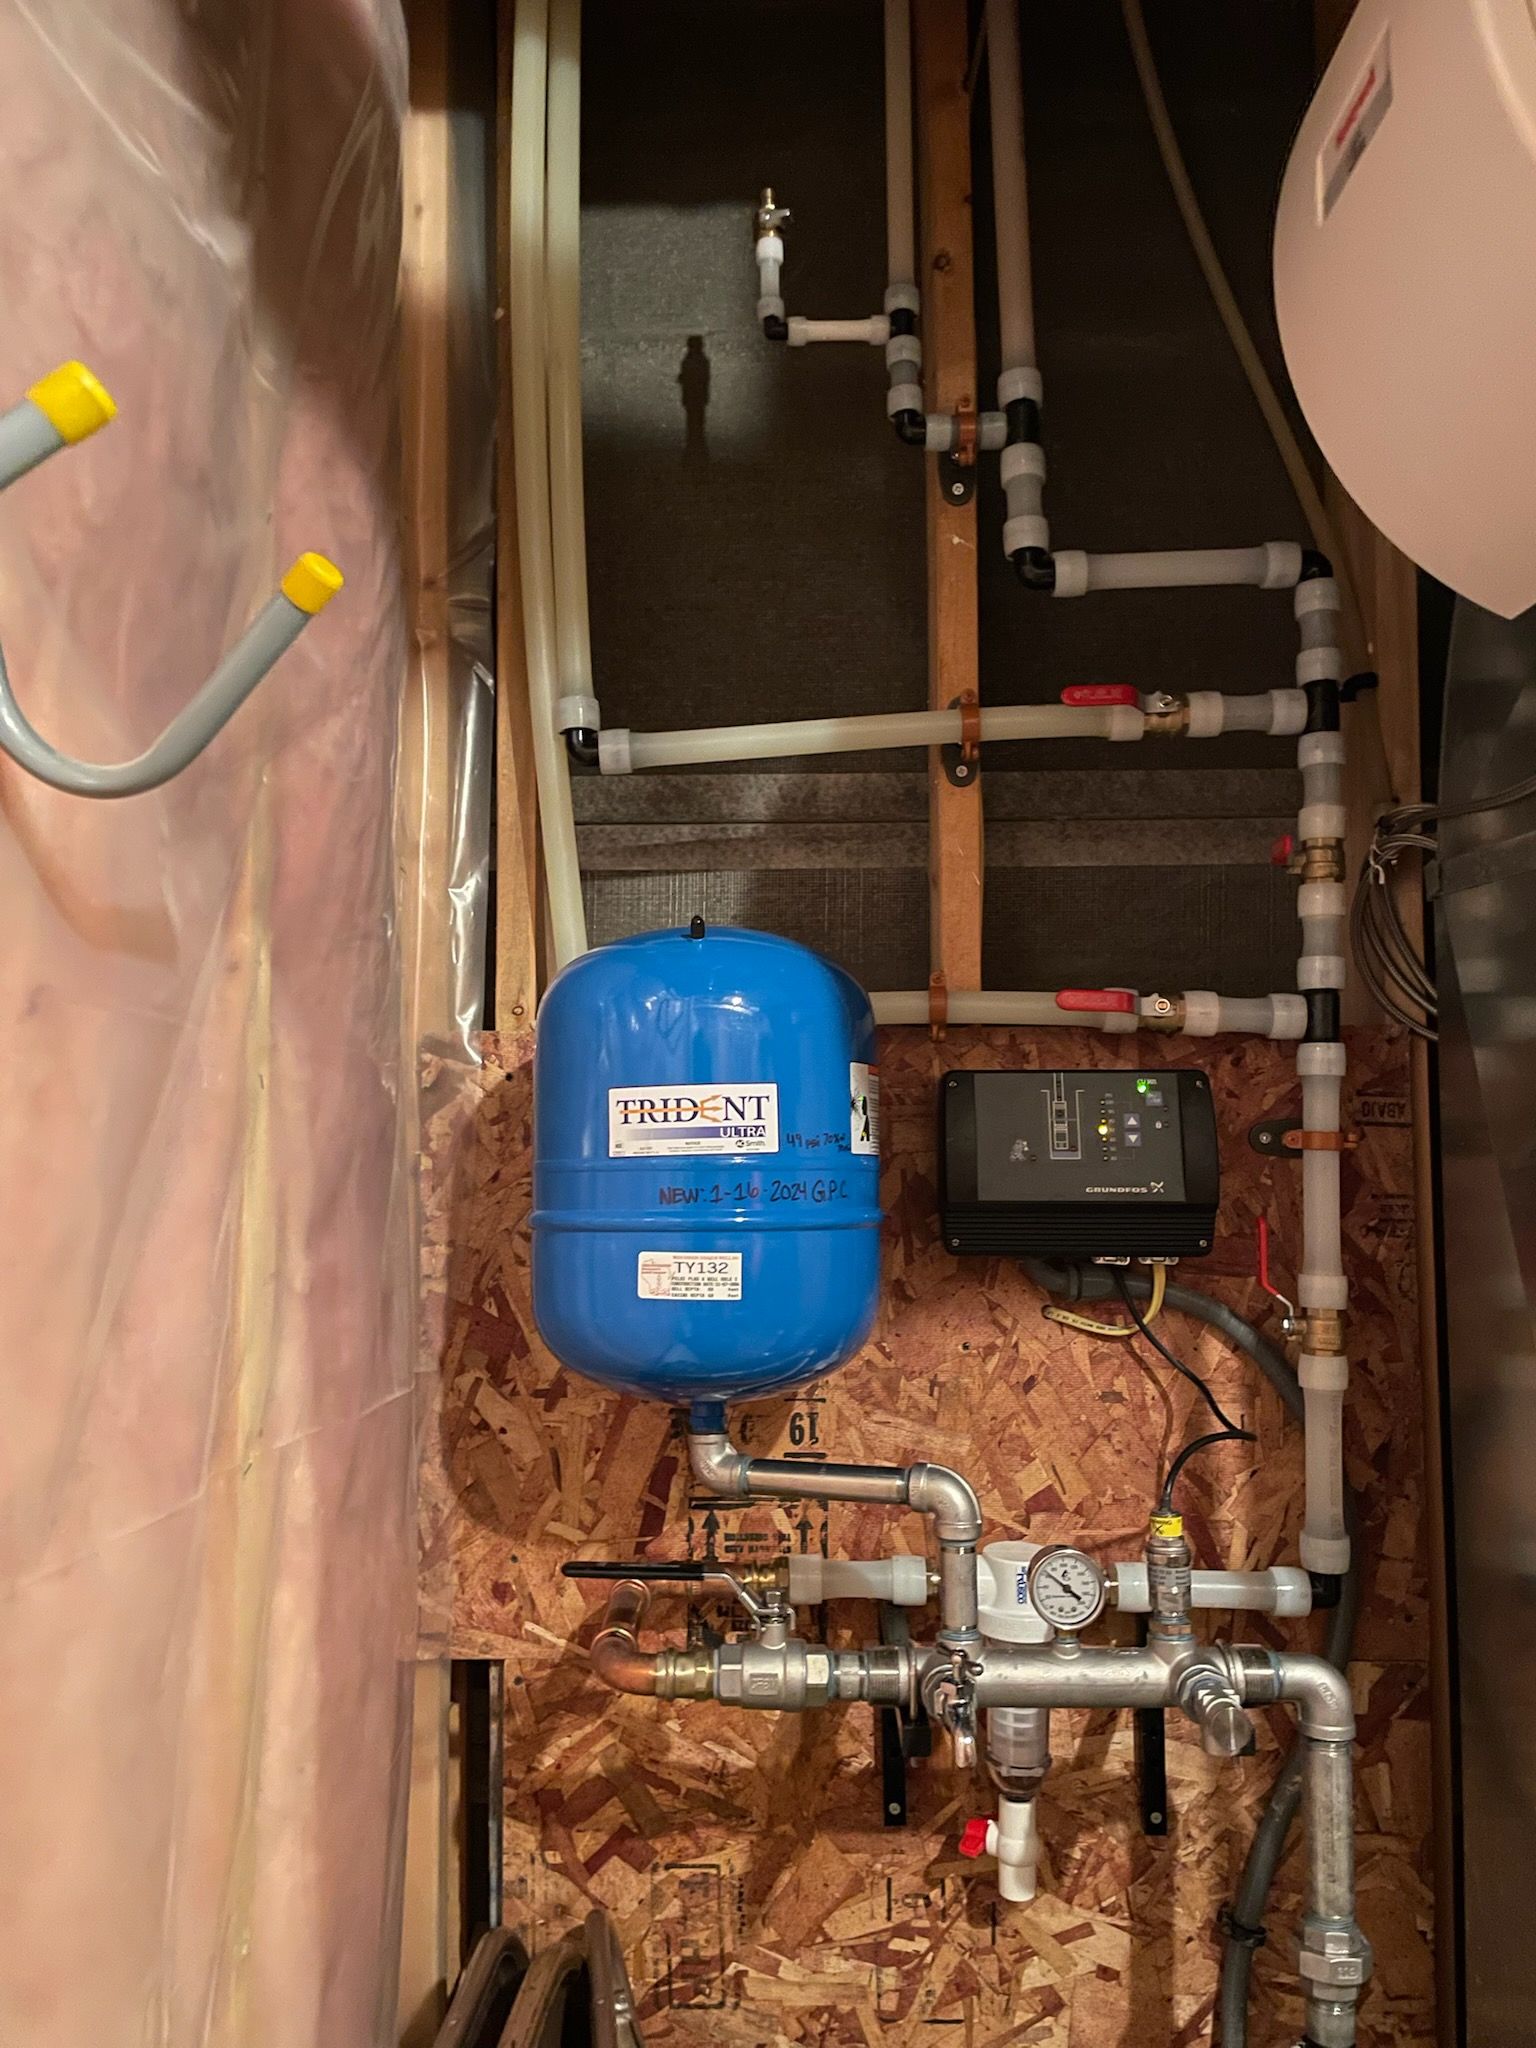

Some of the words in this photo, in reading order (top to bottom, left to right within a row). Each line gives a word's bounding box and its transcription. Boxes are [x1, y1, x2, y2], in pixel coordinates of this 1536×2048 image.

[616, 1094, 770, 1125] TRIDENT
[719, 1126, 766, 1138] ULTRA
[1085, 1186, 1149, 1194] GRUNDFOS
[673, 1261, 729, 1274] TY132
